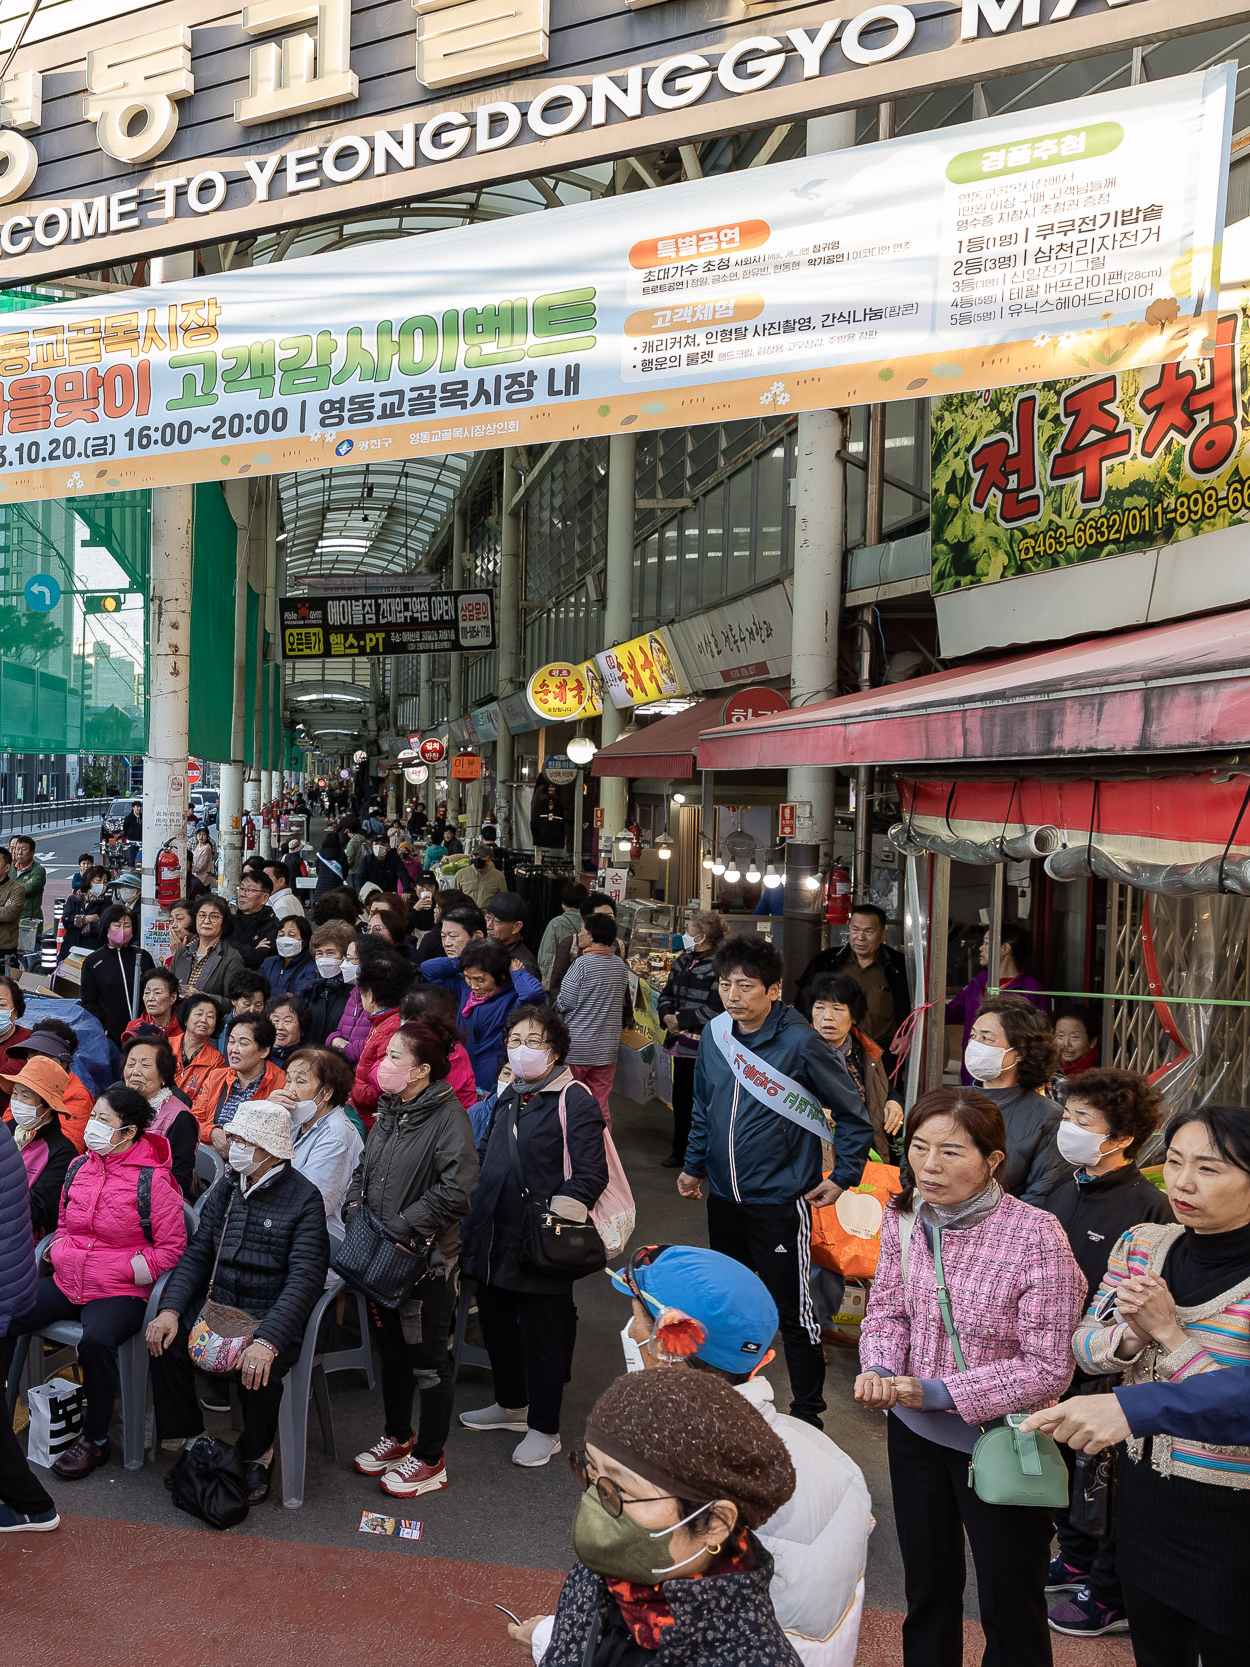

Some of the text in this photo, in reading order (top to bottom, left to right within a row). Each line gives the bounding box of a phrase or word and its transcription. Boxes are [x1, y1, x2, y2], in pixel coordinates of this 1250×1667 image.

[154, 169, 227, 220] TO
[243, 3, 916, 203] YEONGDONGGYO
[981, 131, 1087, 172] 경품추첨
[956, 192, 1111, 232] 영수증 지참시 추첨권 증정
[989, 197, 1016, 212] 이상
[1020, 191, 1046, 205] 구매
[1049, 176, 1118, 201] 고객님들께
[656, 226, 741, 259] 특별공연
[957, 203, 1164, 255] 1등(1명) 쿠쿠전기밥솥
[642, 262, 699, 284] 초대가수
[702, 257, 731, 274] 초청
[734, 255, 762, 268] 사회자
[812, 240, 841, 254] 정귀영
[807, 253, 846, 267] 악기공연
[953, 226, 1162, 277] 2등(3명) 삼천리자전거
[642, 280, 685, 296] 트로트공연
[951, 255, 1106, 294] 3등(3명) 신일전기그릴
[651, 298, 737, 330] 고객체험
[950, 293, 998, 310] 4등(5명)
[1008, 283, 1040, 300] 테팔
[950, 283, 1155, 326] 5등(5명) 유닉스헤어드라이어
[641, 302, 920, 355] 캐리커쳐, 인형탈 사진촬영, 간식나눔(팝콘)
[164, 285, 598, 412] 고객감사이벤트
[640, 355, 682, 373] 행운의
[686, 350, 715, 367] 룰렛
[124, 406, 289, 451] 16:00~20:00
[318, 368, 538, 429] 영동교골목시장
[547, 362, 581, 397] 내
[357, 420, 520, 451] 광진구 영동교골목시장상인회
[327, 596, 456, 626] 에이블짐 건대입구역점 OPEN
[460, 601, 490, 622] 상담문의
[288, 632, 322, 653] 오픈특가
[426, 742, 440, 750] 김치
[733, 1053, 786, 1097] 가을맞이
